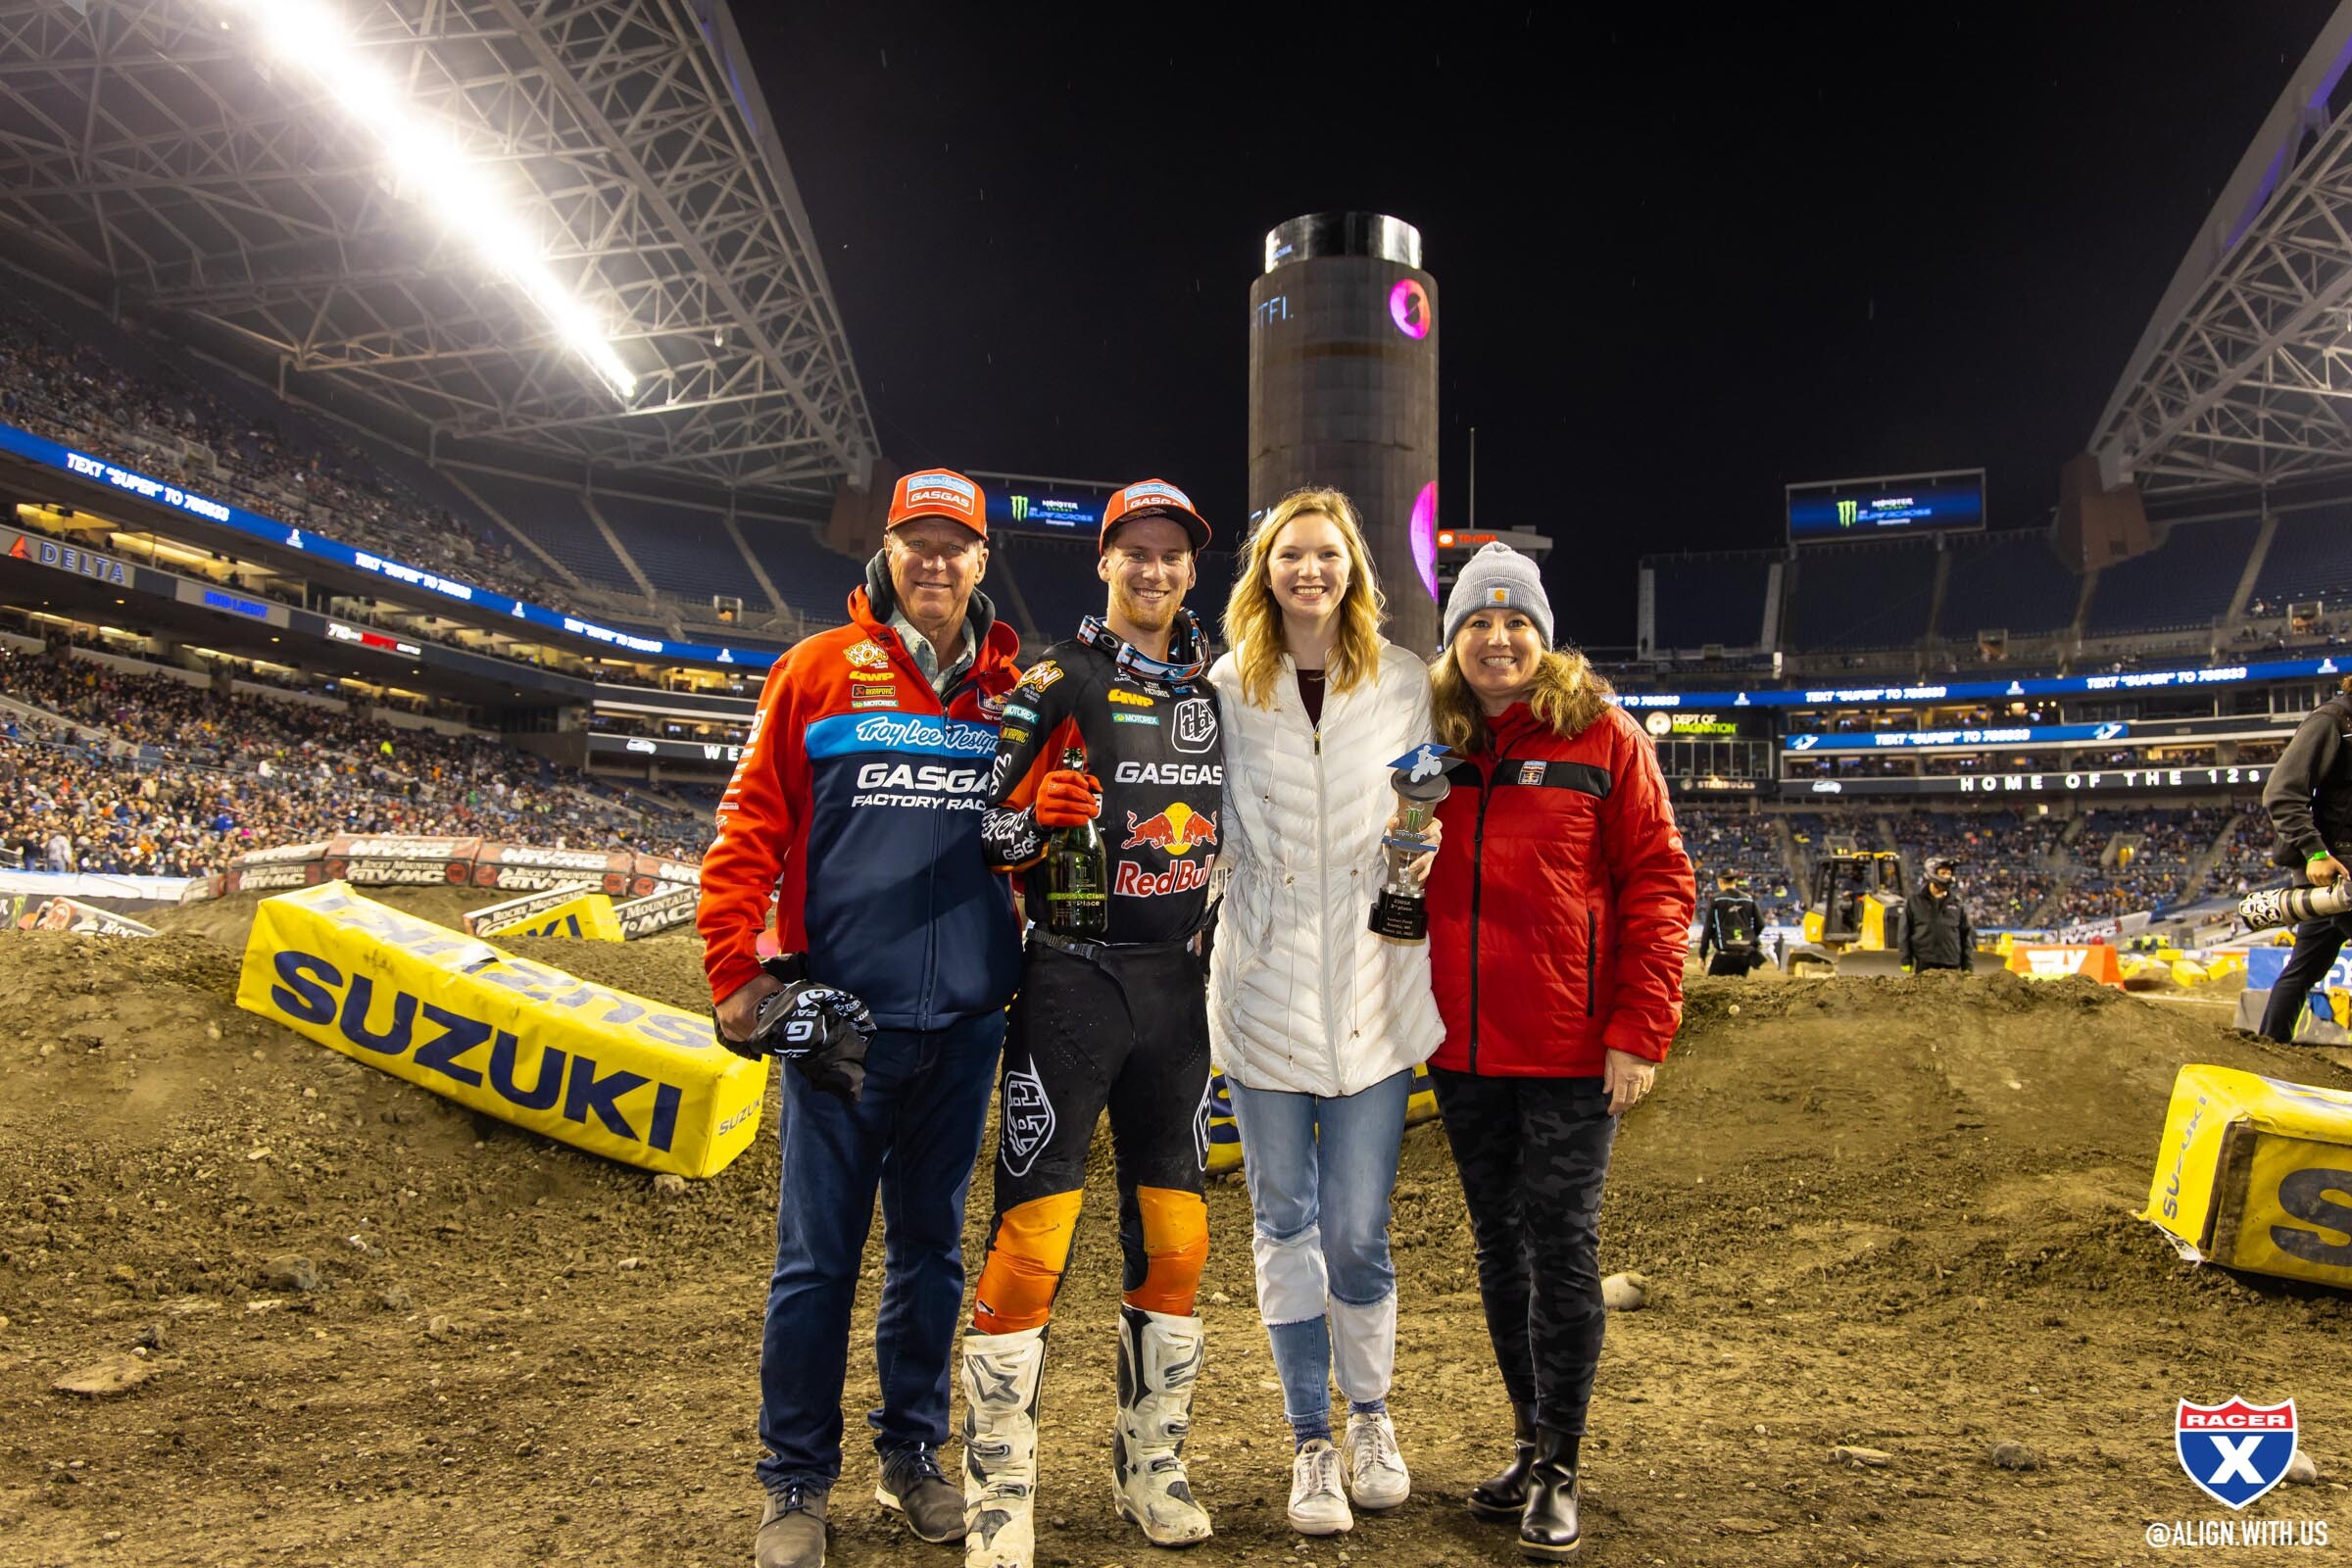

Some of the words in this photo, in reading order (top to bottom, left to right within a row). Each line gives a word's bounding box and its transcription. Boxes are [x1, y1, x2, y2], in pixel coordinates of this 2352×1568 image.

[67, 453, 105, 478] TEXT
[165, 487, 183, 506] TO
[911, 491, 969, 508] GASGAS
[1042, 500, 1078, 510] MONSTER
[1130, 497, 1178, 509] GASG
[1872, 498, 1913, 508] MONSTER
[40, 542, 125, 585] DELTA
[2086, 676, 2119, 689] TEXT
[2177, 671, 2196, 683] TO
[1625, 696, 1640, 706] TO
[1805, 691, 1836, 703] TEXT
[1885, 688, 1903, 699] TO
[1005, 705, 1038, 722] MOTOREX
[1125, 714, 1157, 724] MOTOREX
[1672, 714, 1700, 723] DEPT
[1700, 714, 1717, 724] OF
[857, 716, 903, 746] Troy
[904, 719, 944, 746] Lee
[944, 724, 999, 755] Design
[1875, 733, 1907, 746] TEXT
[1962, 730, 1982, 742] TO
[858, 762, 991, 794] GASGA
[1114, 761, 1223, 785] GASGAS
[1961, 774, 2043, 791] HOME
[2065, 772, 2100, 789] OF
[2123, 770, 2181, 787] THE
[852, 793, 944, 810] FACTORY
[946, 799, 986, 810] RAC
[392, 861, 445, 870] MOUNTAIN
[550, 869, 605, 880] MOUNTAIN
[1113, 859, 1177, 898] Red
[1175, 855, 1215, 893] Bull
[626, 890, 693, 919] MOUNTAIN
[493, 905, 528, 922] ROCKY
[270, 951, 683, 1152] SUZUKI
